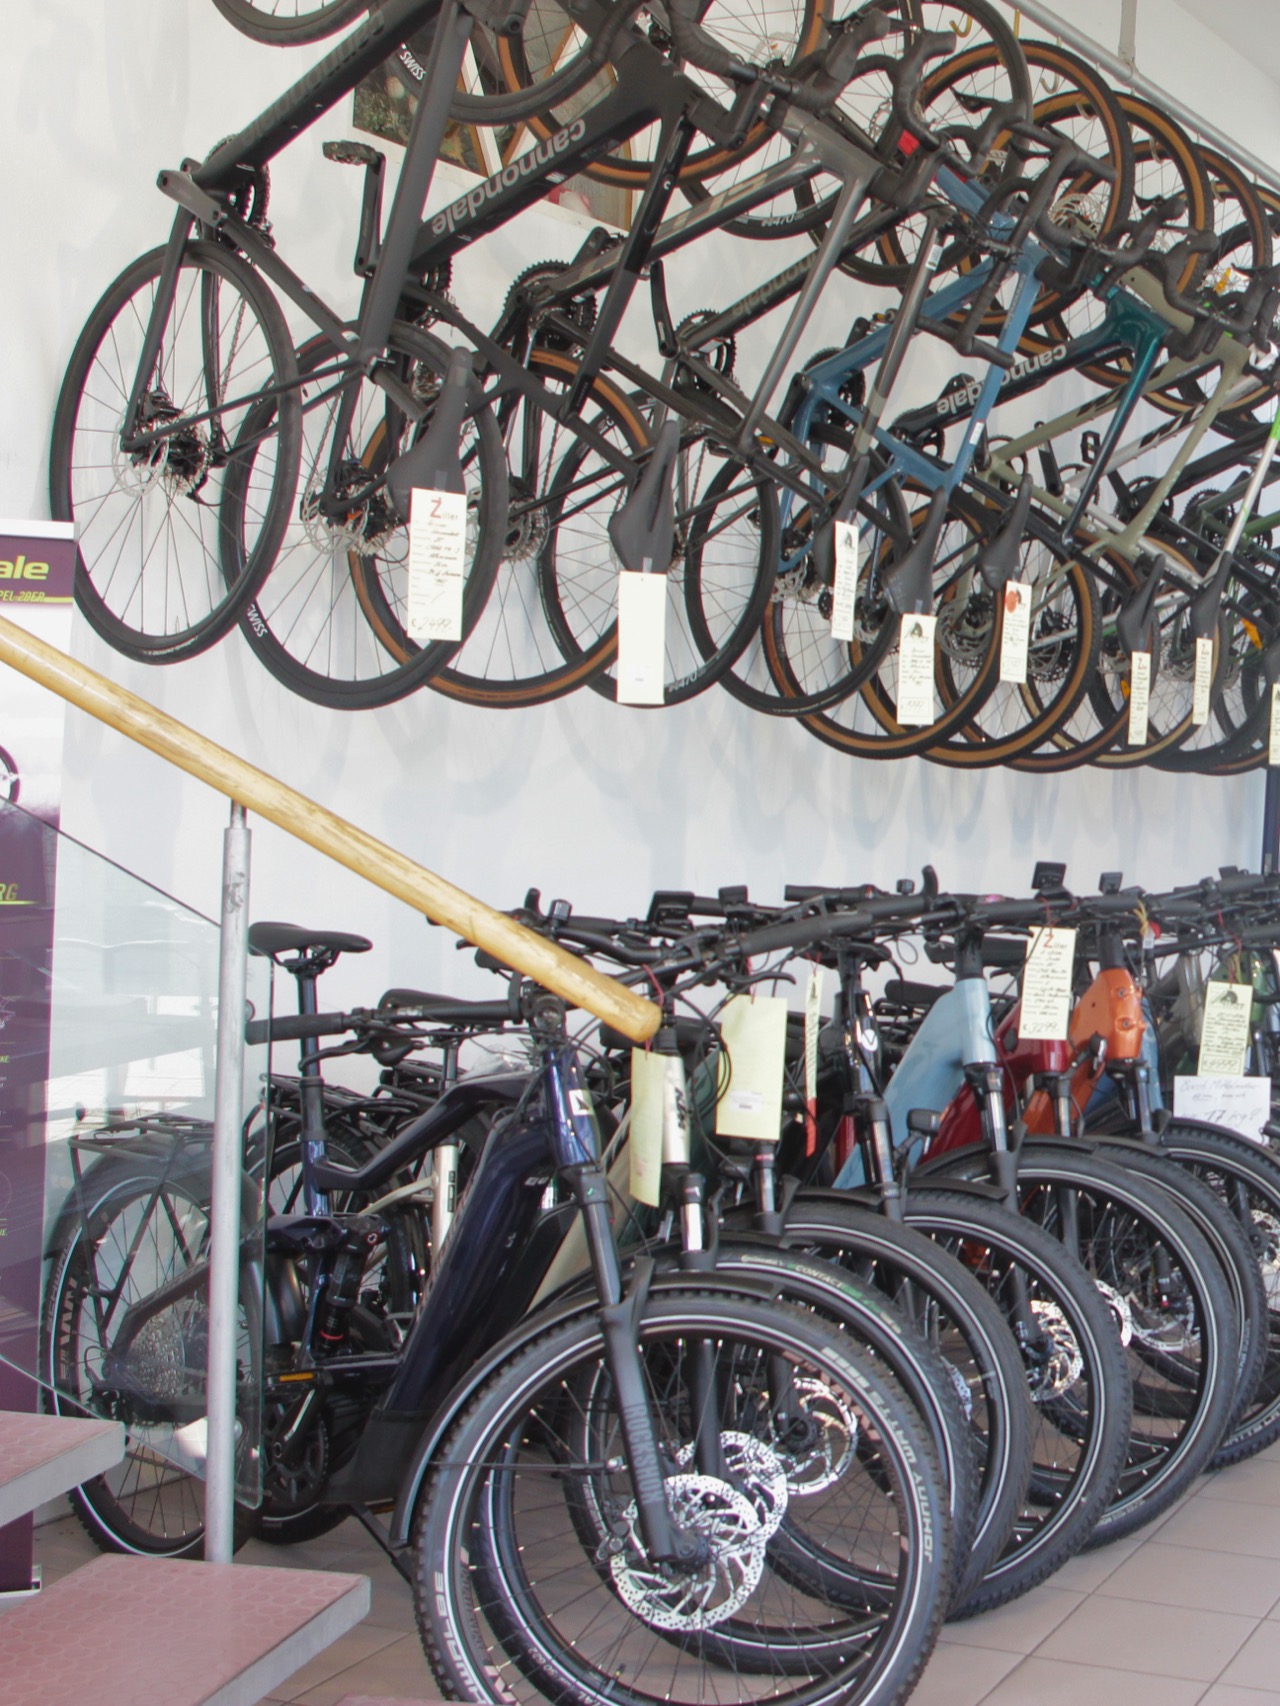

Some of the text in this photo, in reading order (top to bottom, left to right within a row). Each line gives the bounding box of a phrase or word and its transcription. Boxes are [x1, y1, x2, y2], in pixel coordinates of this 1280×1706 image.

[400, 50, 427, 81] SWISS
[432, 119, 586, 235] cannondale
[869, 1389, 933, 1564] JOHNNY WATTS
